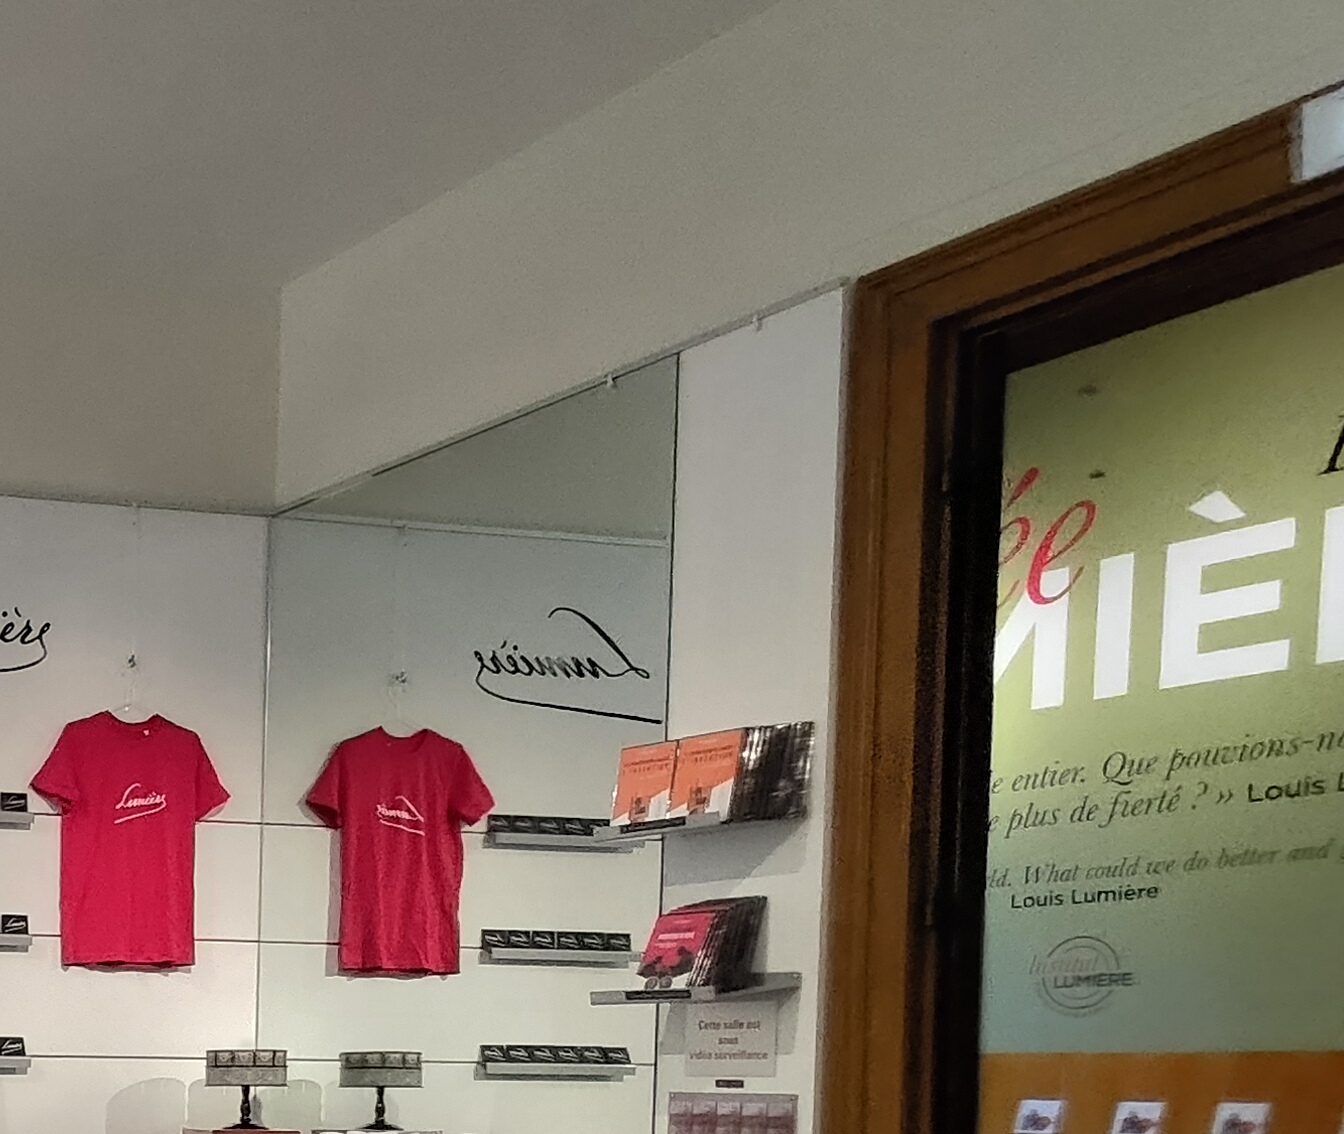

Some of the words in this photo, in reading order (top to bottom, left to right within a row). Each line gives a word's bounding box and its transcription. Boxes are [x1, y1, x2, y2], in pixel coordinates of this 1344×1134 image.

[1012, 760, 1086, 793] entier.
[1101, 751, 1159, 787] Que
[1003, 802, 1061, 840] plus
[1069, 796, 1100, 824] de
[1097, 785, 1183, 829] fierté
[1248, 776, 1326, 803] Louis
[1024, 862, 1081, 885] What
[1085, 855, 1141, 880] could
[1146, 858, 1177, 876] we
[1183, 850, 1210, 872] do
[1010, 890, 1065, 909] Louis
[1071, 883, 1160, 905] Lumière
